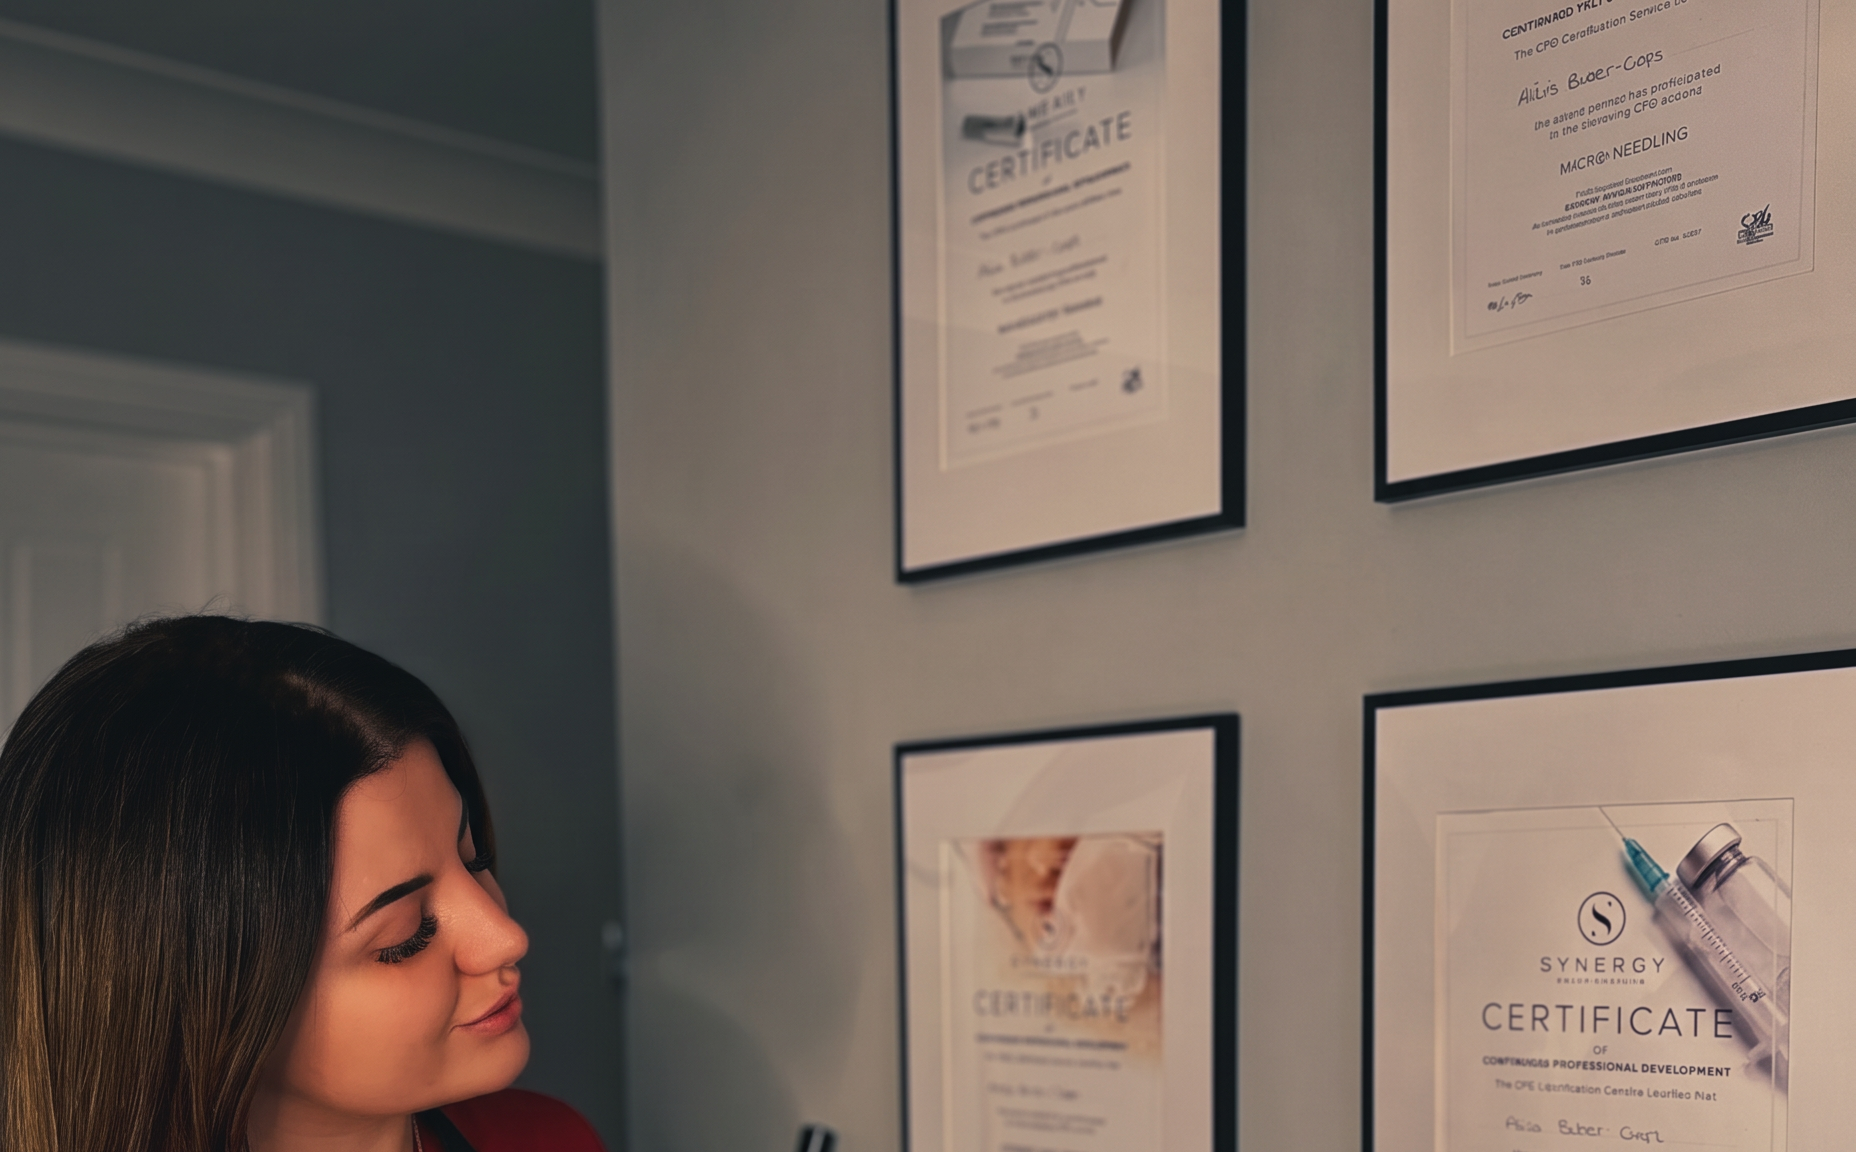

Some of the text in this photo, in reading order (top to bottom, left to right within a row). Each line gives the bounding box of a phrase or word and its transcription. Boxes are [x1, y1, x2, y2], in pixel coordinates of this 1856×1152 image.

[1514, 47, 1533, 61] The
[1628, 86, 1647, 102] has
[1562, 123, 1579, 137] the
[1612, 126, 1689, 161] NEEDLING
[967, 110, 1132, 195] CERTIFICATE
[1540, 956, 1665, 973] SYNERGY
[1482, 1002, 1733, 1039] CERTIFICATE
[1593, 1046, 1608, 1055] OF
[1553, 1059, 1638, 1073] PROFESSIONAL
[1641, 1063, 1731, 1078] DEVELOPMENT
